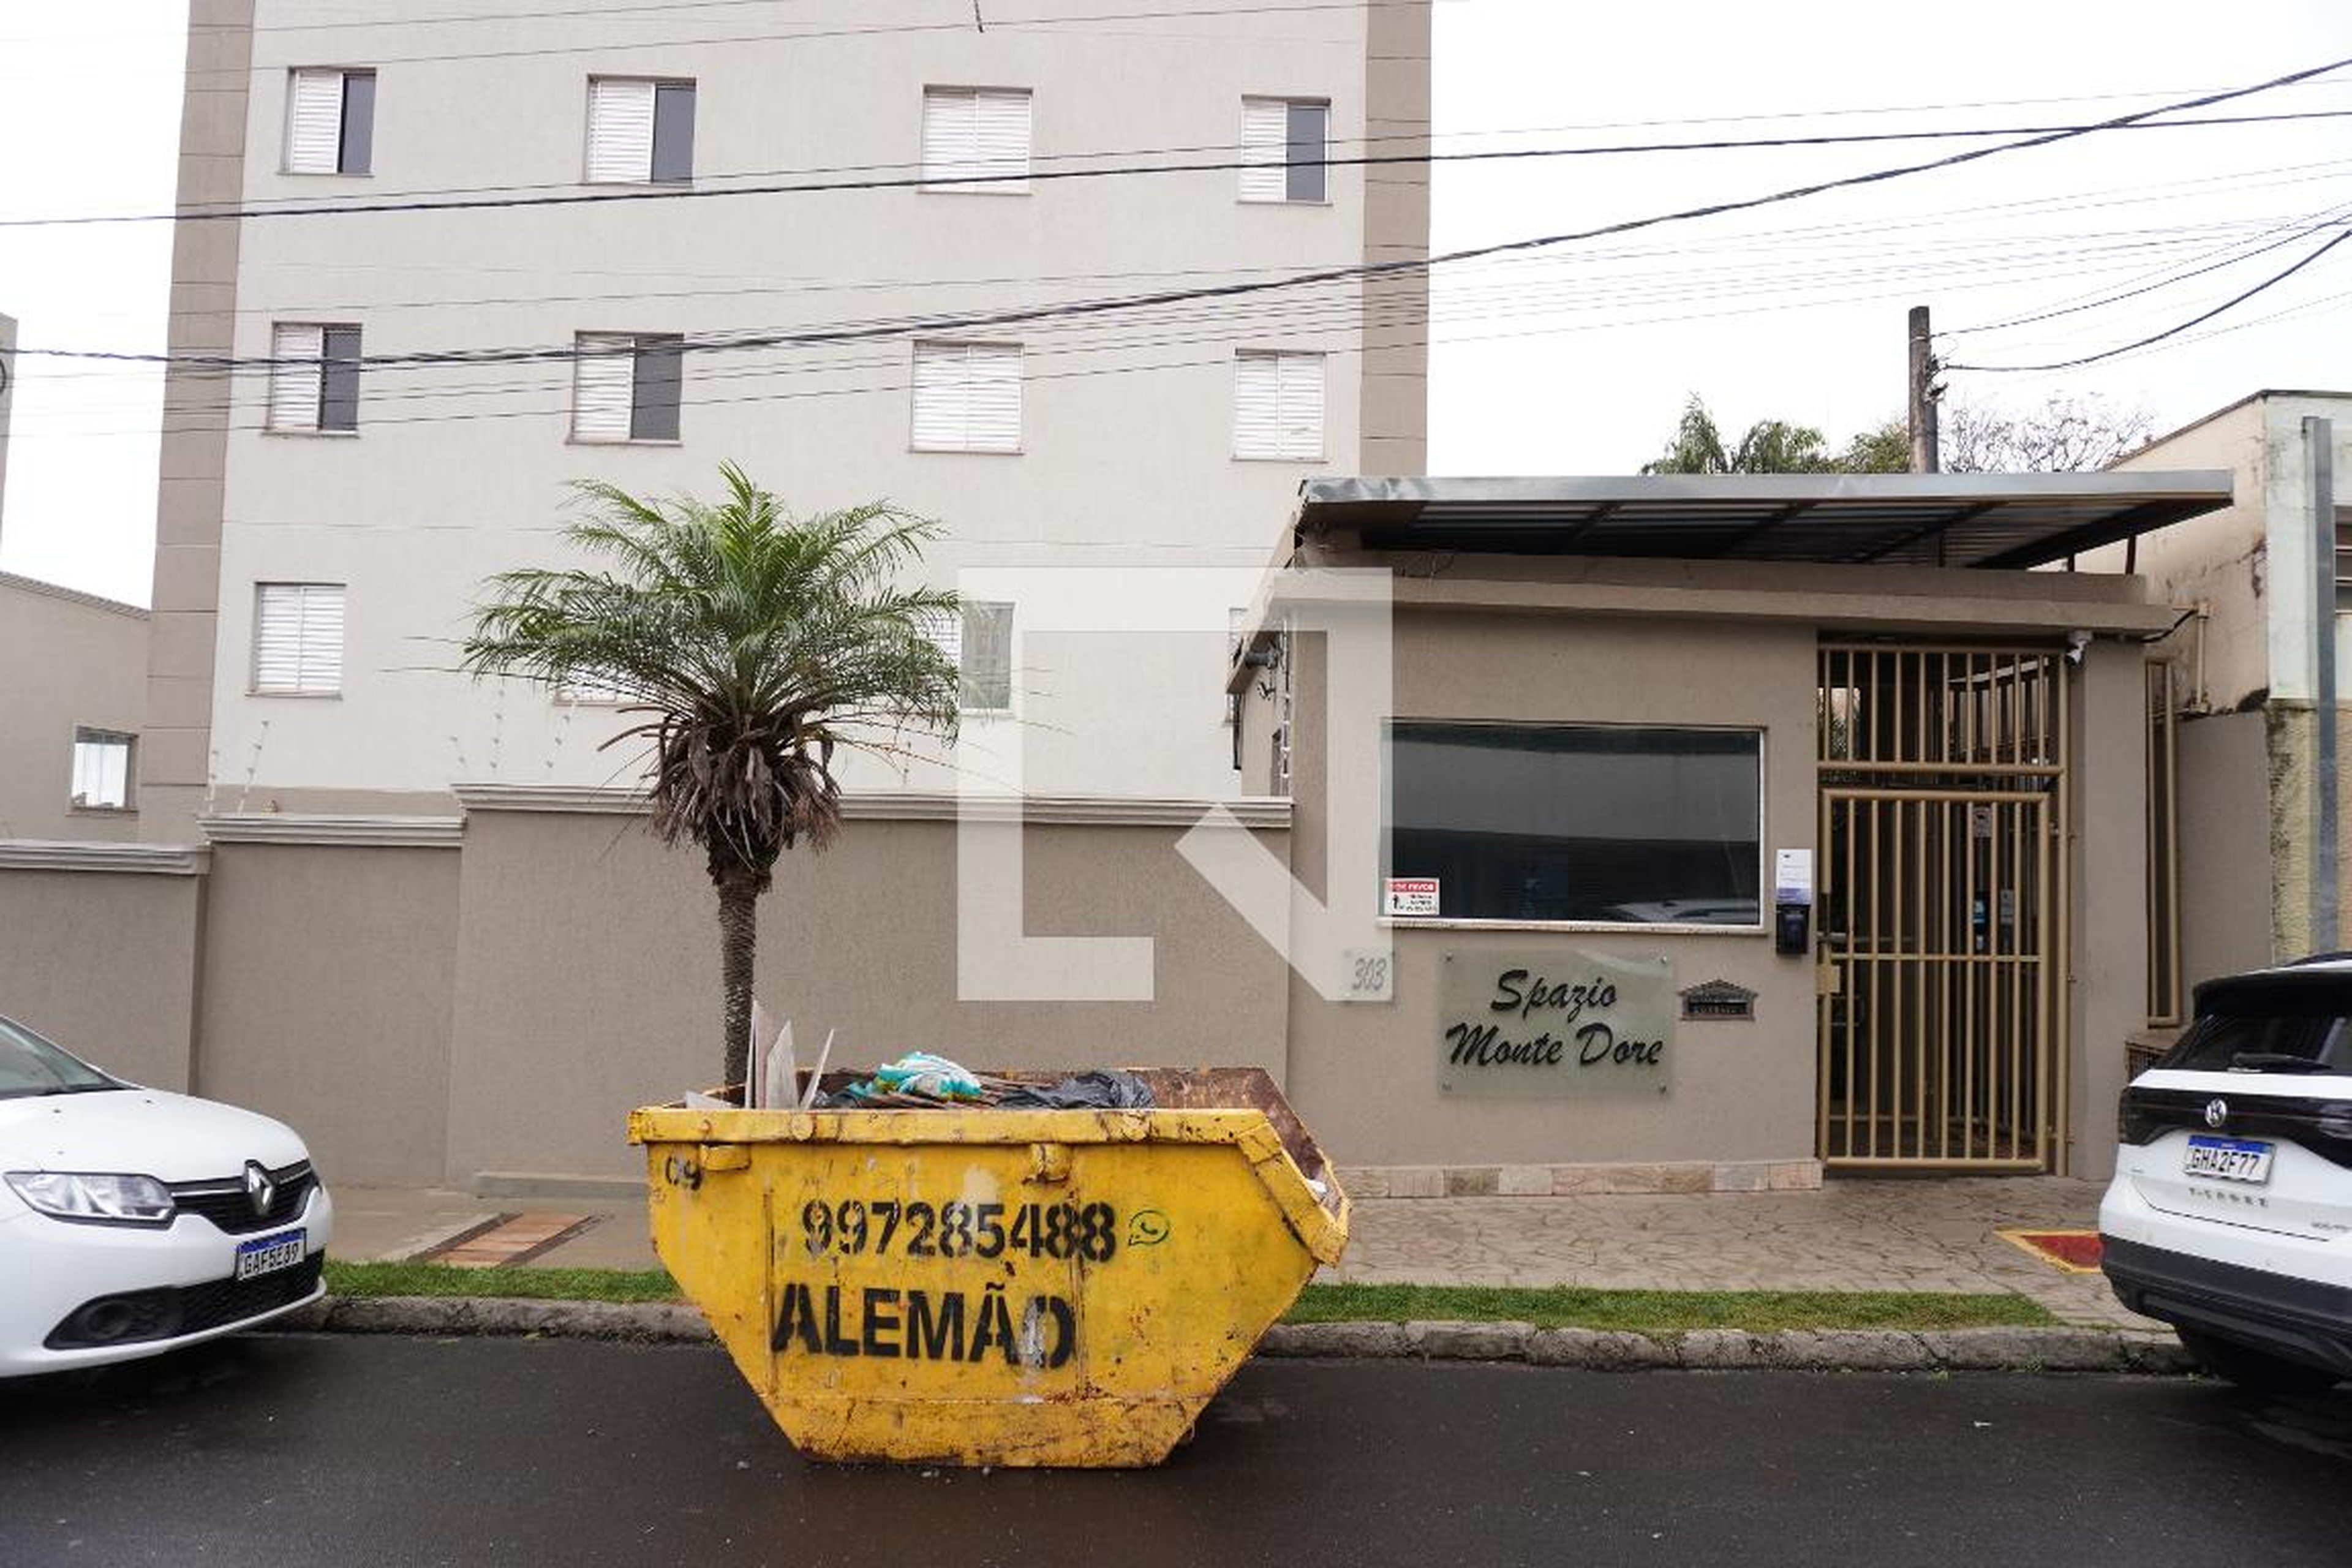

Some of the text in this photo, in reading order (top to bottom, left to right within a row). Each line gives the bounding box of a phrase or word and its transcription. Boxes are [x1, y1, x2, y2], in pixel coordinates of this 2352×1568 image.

[1352, 957, 1387, 990] 303
[1490, 969, 1618, 1023] Spazio
[1445, 1022, 1664, 1066] Monte Dore
[2191, 1148, 2260, 1175] GHA2F77
[802, 1199, 1117, 1262] 997285488
[771, 1282, 1076, 1369] ALEMÃO
